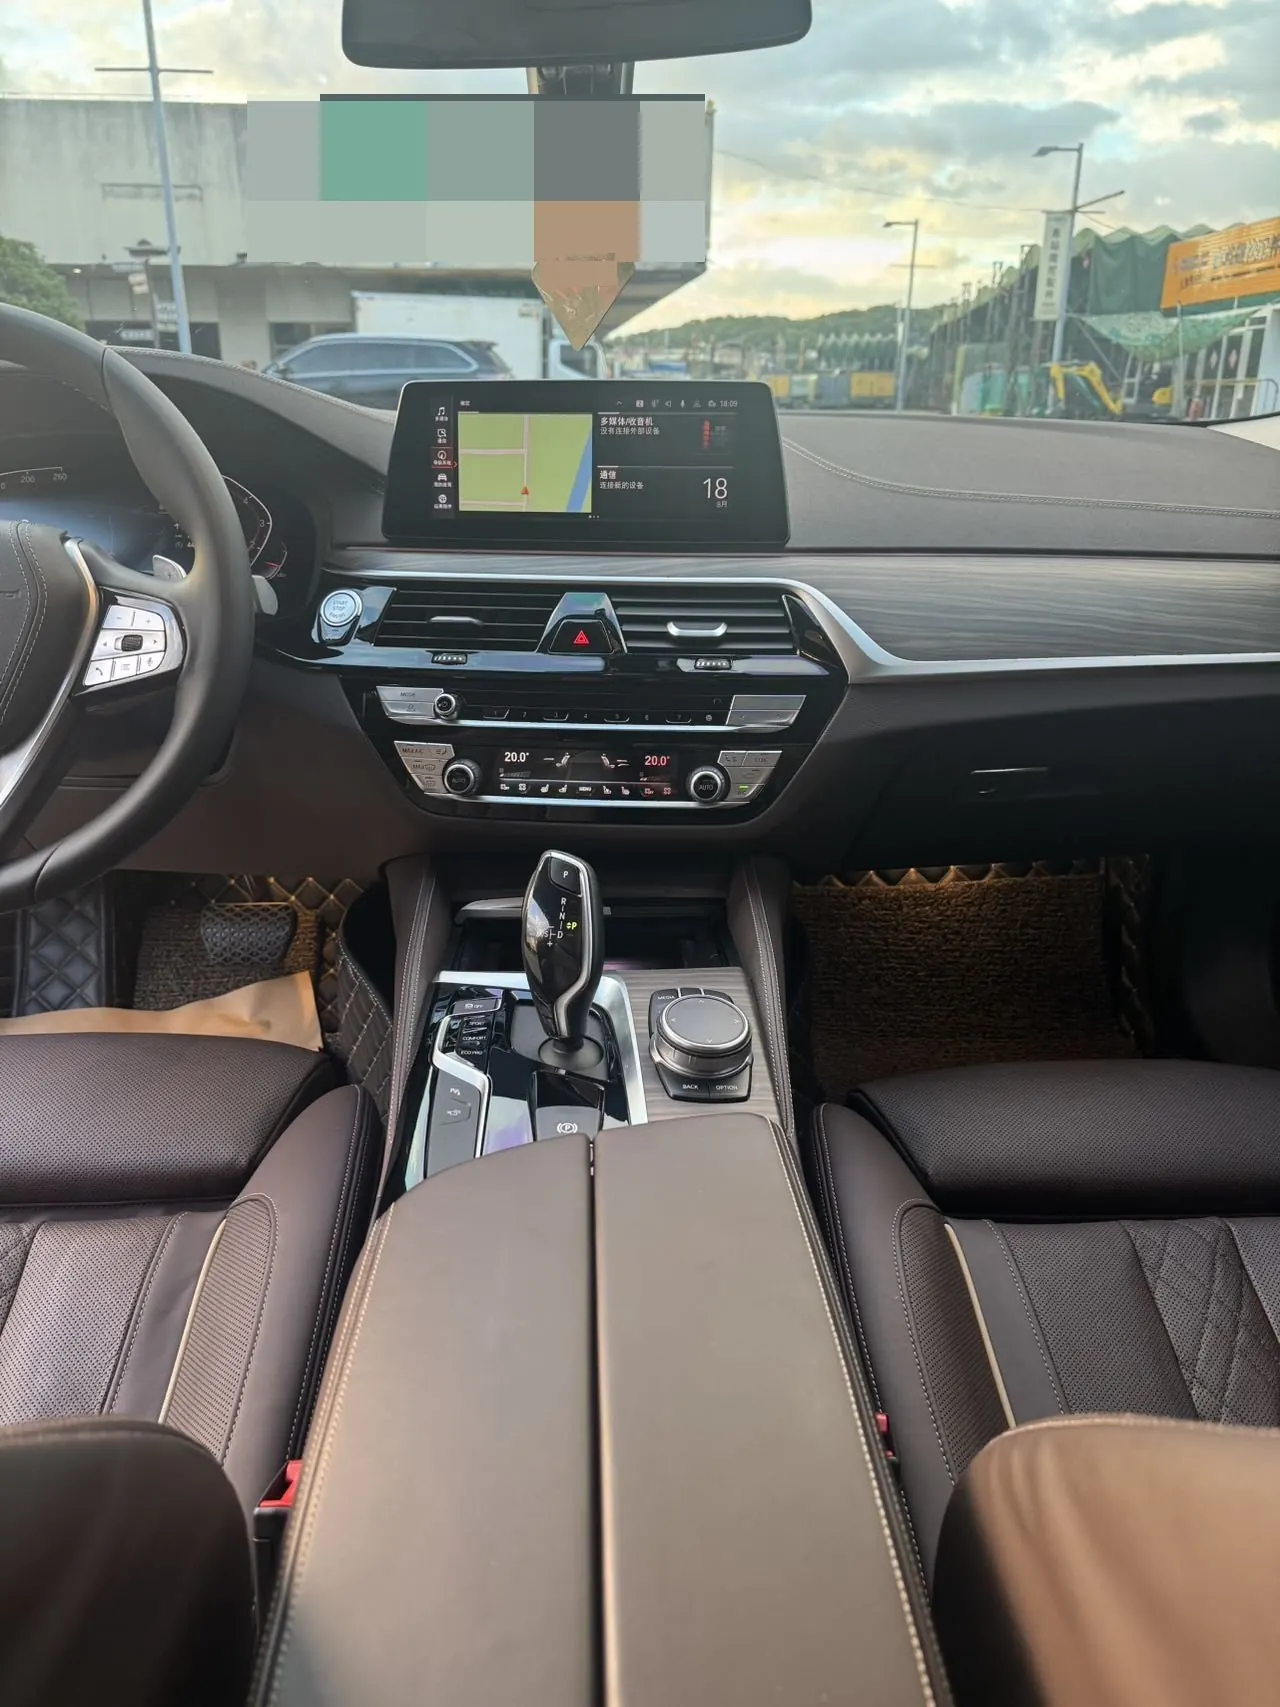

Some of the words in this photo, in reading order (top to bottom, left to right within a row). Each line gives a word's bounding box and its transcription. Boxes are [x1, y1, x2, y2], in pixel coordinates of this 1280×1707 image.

[719, 400, 738, 408] 18:09
[600, 416, 653, 426] 多媒体/收音机
[600, 470, 617, 480] 通信
[600, 481, 644, 490] 连接新的设备
[702, 477, 728, 499] 18
[259, 519, 265, 527] 3
[560, 897, 567, 905] R
[559, 912, 566, 920] N
[571, 922, 578, 930] P
[557, 930, 564, 939] D
